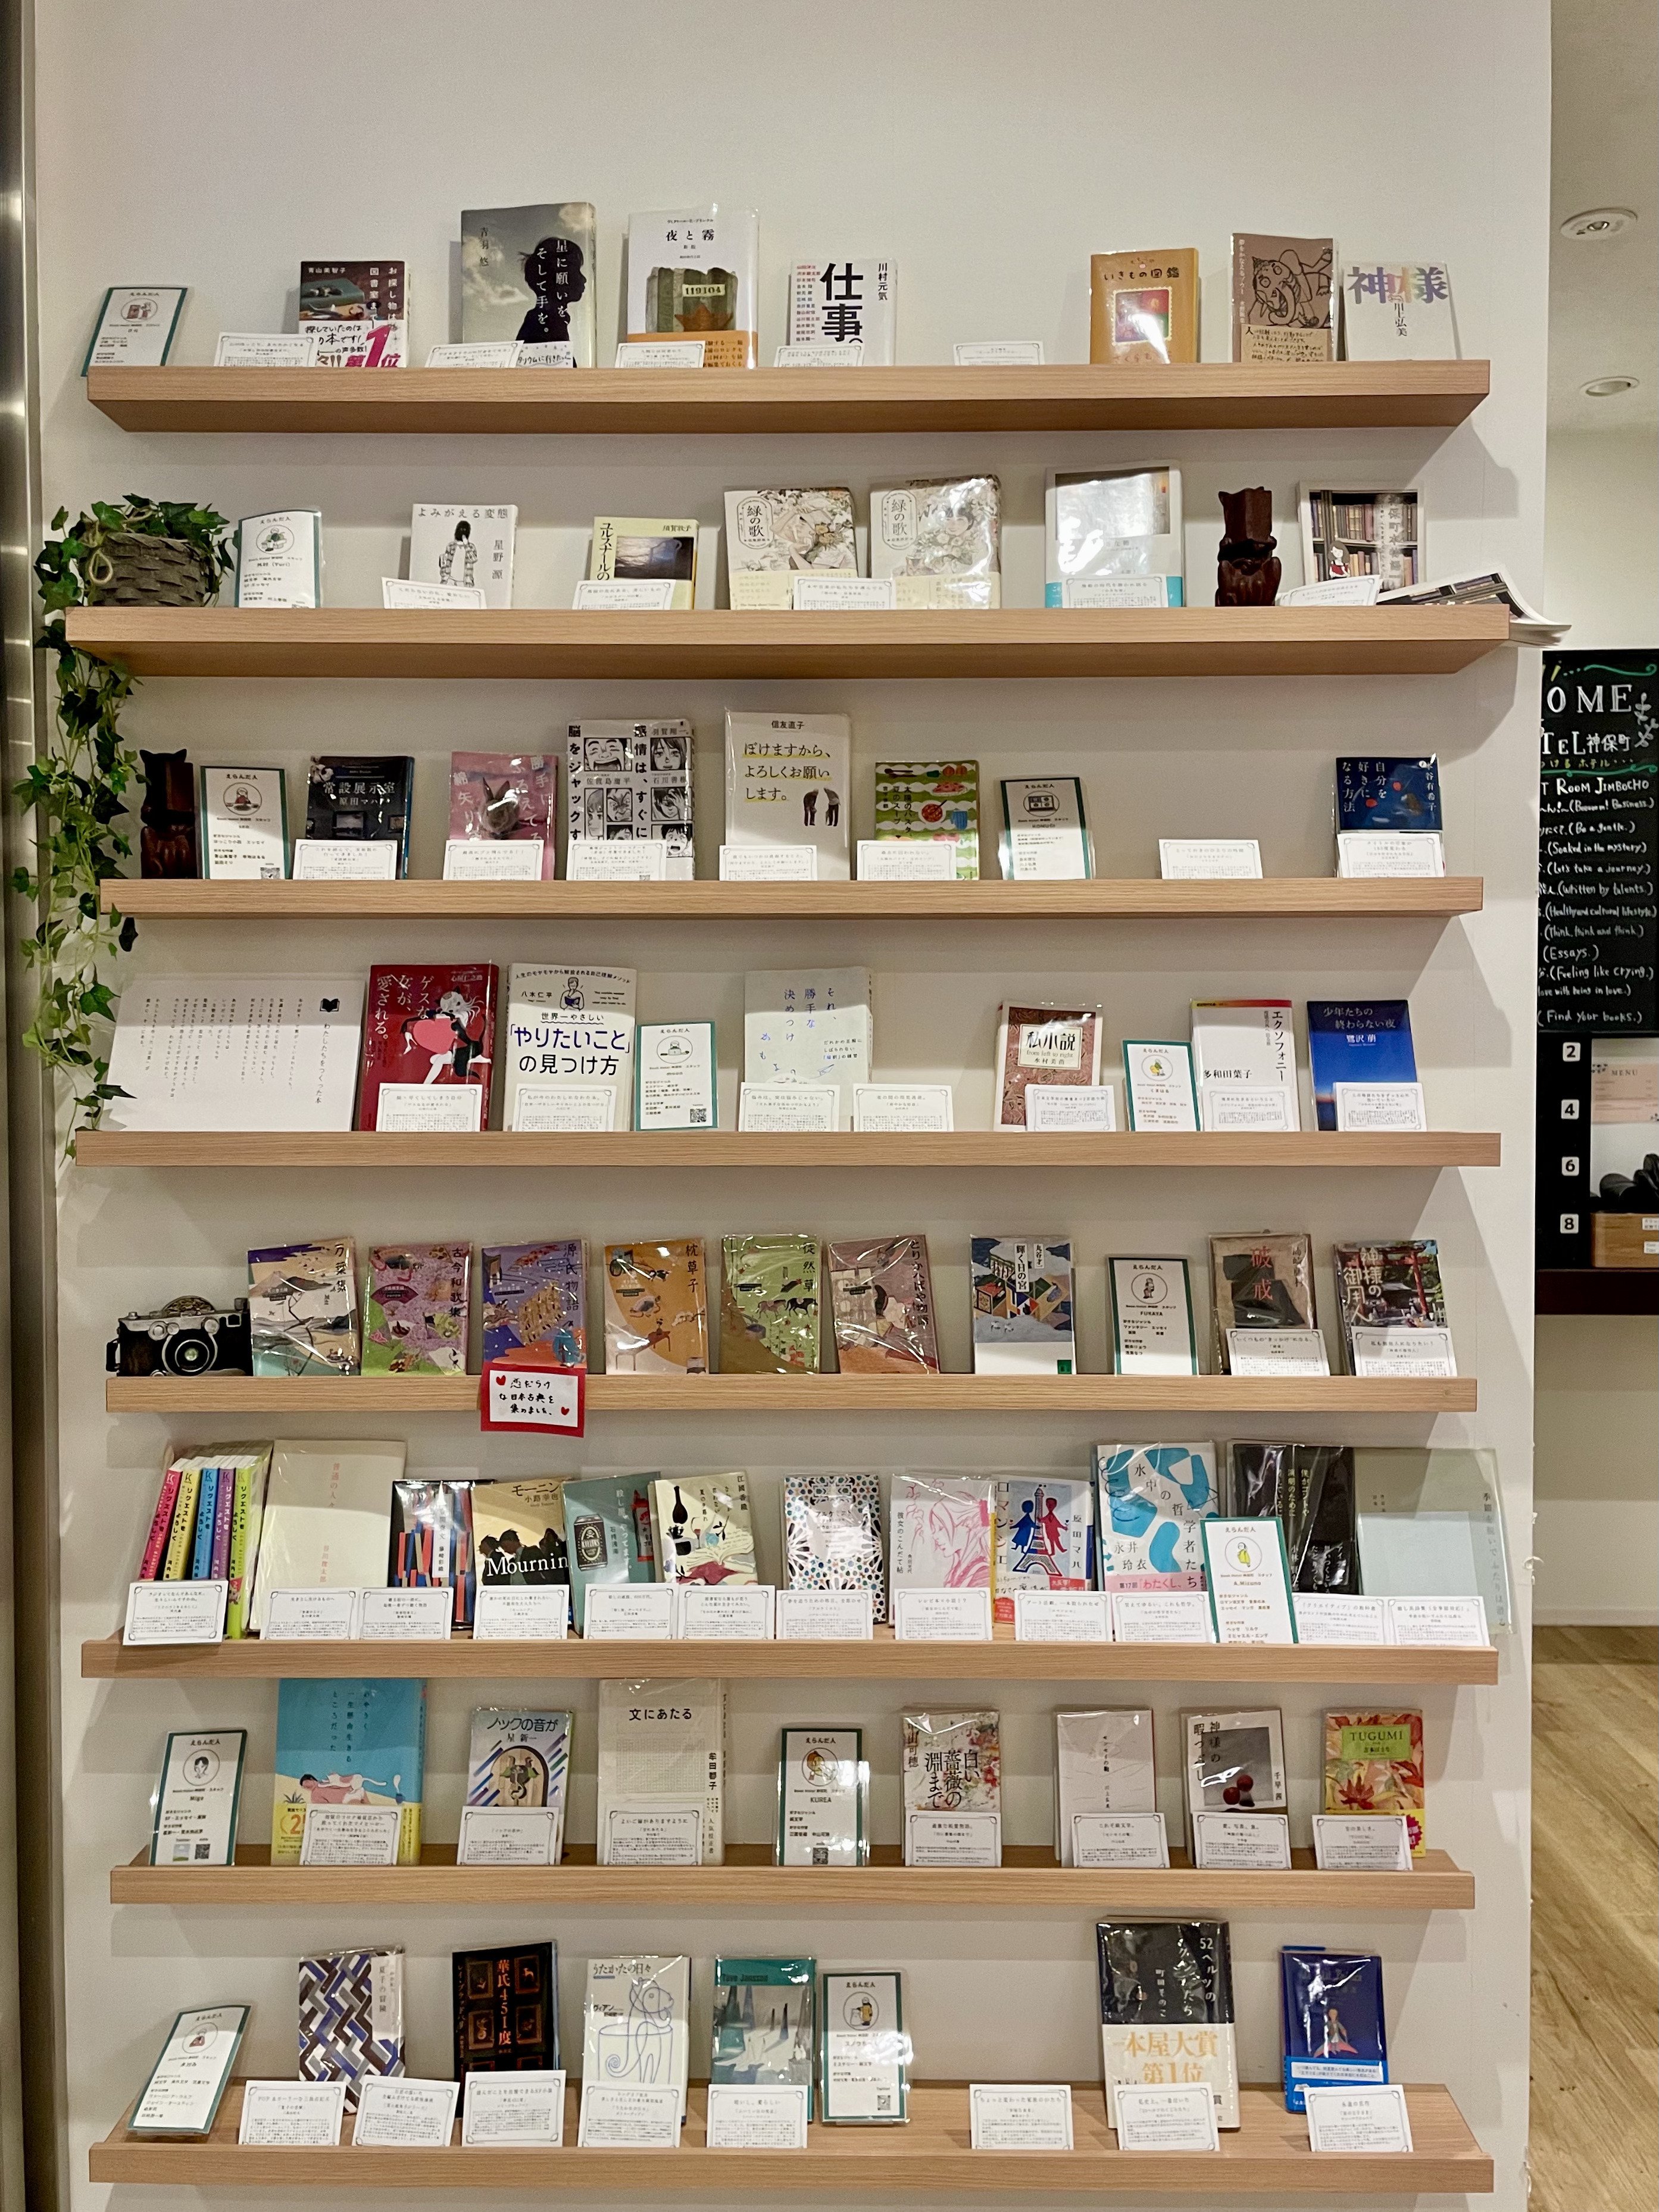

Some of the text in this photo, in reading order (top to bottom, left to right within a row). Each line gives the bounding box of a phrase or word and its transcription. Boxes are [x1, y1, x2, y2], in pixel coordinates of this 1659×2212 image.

[666, 229, 716, 242] 夜と霧
[555, 239, 570, 325] 星に願いを、
[877, 263, 888, 301] 川村元気
[1104, 266, 1179, 280] いきもの図鑑
[1348, 266, 1449, 304] 神様
[535, 247, 549, 333] そして手を。
[685, 286, 721, 295] 119104
[418, 507, 508, 519] よみがえる変態
[746, 505, 764, 537] 緑の歌
[891, 499, 908, 536] 緑の歌
[492, 539, 504, 580] 星野源
[596, 523, 614, 581] ユルスナールの
[771, 720, 805, 730] 信友直子
[744, 743, 831, 758] ぼけますから、
[568, 725, 582, 841] 脳をジャックす
[635, 725, 648, 838] 感情は、すぐに
[744, 766, 830, 780] よろしくお願い
[1358, 761, 1371, 798] 好きに
[1375, 761, 1388, 799] 自分を
[323, 782, 396, 795] 常設展示室
[745, 788, 788, 801] します。
[1342, 761, 1355, 813] なる方法
[1548, 841, 1582, 856] (Soaked
[1583, 842, 1592, 853] in
[1598, 883, 1610, 897] by
[1589, 904, 1620, 917] cultural
[1596, 925, 1612, 936] and
[1543, 944, 1599, 964] (Essays.)
[1549, 964, 1590, 982] (Feeling
[1594, 965, 1610, 977] like
[396, 974, 414, 1011] 女が、
[417, 976, 434, 1020] ゲスな
[1555, 985, 1570, 996] with
[1595, 986, 1604, 995] in
[374, 974, 392, 1039] 愛される。
[783, 989, 796, 1042] 決めつけ
[804, 988, 817, 1029] 勝手な
[827, 987, 838, 1020] それ、
[1323, 1007, 1373, 1017] 少年たちの
[541, 1012, 604, 1021] 世界一やさしい
[1335, 1018, 1396, 1030] 終わらない夜
[510, 1023, 630, 1054] 「やりたいこと」
[1026, 1031, 1076, 1051] 私小説
[1271, 1011, 1287, 1082] エクソフォニー
[1566, 1045, 1576, 1058] 2
[519, 1054, 619, 1076] の見つけ方
[1203, 1069, 1252, 1079] 多和田葉子
[1564, 1103, 1575, 1116] 4
[1565, 1160, 1575, 1173] 6
[1564, 1217, 1574, 1231] 8
[563, 1244, 580, 1311] 源氏物語
[685, 1244, 699, 1294] 枕草子
[802, 1242, 816, 1292] 徒然草
[1016, 1244, 1027, 1291] 輝く日の宮
[1251, 1245, 1273, 1302] 破戒
[1360, 1247, 1383, 1298] 神様の
[449, 1247, 464, 1317] 古今和歌集
[1343, 1267, 1372, 1323] 御用人
[510, 1378, 551, 1389] 恋だらけ
[510, 1404, 552, 1416] 集めました。
[524, 1493, 560, 1504] 小路幸也
[1114, 1541, 1139, 1554] 永井
[1122, 1559, 1147, 1570] 玲衣
[486, 1717, 559, 1732] ノックの音が
[629, 1707, 692, 1721] 文にあたる
[1210, 1721, 1221, 1763] 神様の
[1349, 1730, 1403, 1742] TUGUMI
[963, 1750, 980, 1783] 白い
[924, 1751, 942, 1808] 淵まで
[943, 1750, 962, 1808] 薔薇の
[593, 1963, 651, 1975] うたかたの日々
[1199, 1938, 1218, 2002] 52ヘルツの
[498, 1959, 512, 2045] 華氏451度
[1125, 2032, 1219, 2058] 本屋大賞
[1142, 2062, 1204, 2083] 第1位
